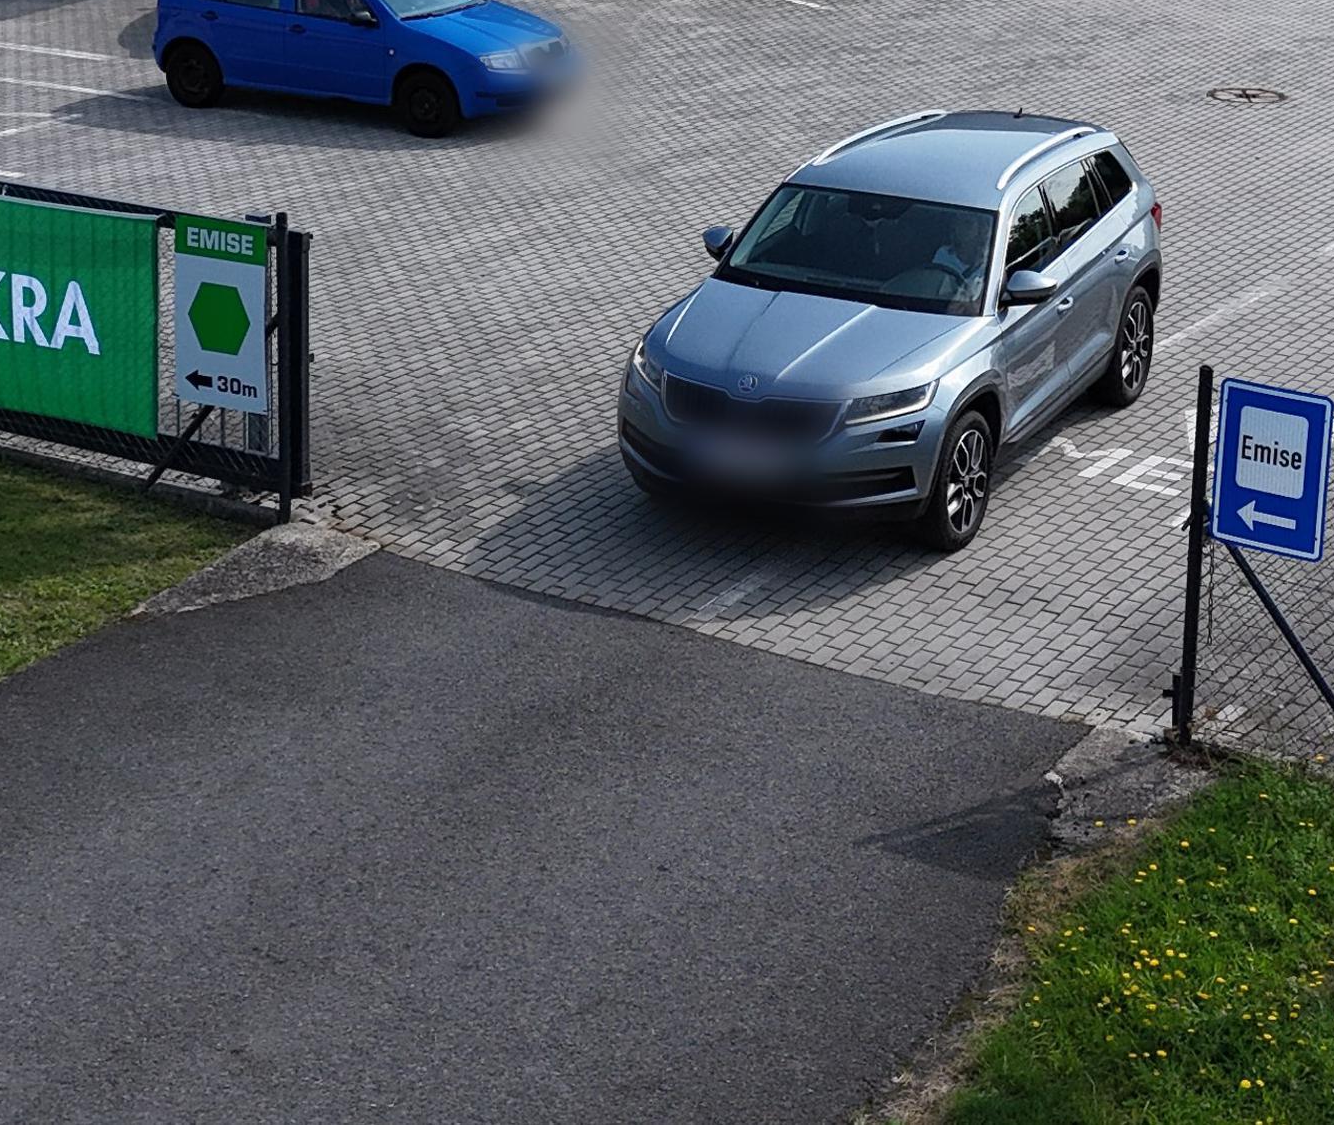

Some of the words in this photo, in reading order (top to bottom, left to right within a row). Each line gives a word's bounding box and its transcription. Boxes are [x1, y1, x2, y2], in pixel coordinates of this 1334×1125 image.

[186, 226, 254, 256] EMISE
[217, 376, 258, 398] 30m
[1241, 434, 1302, 470] Emise
